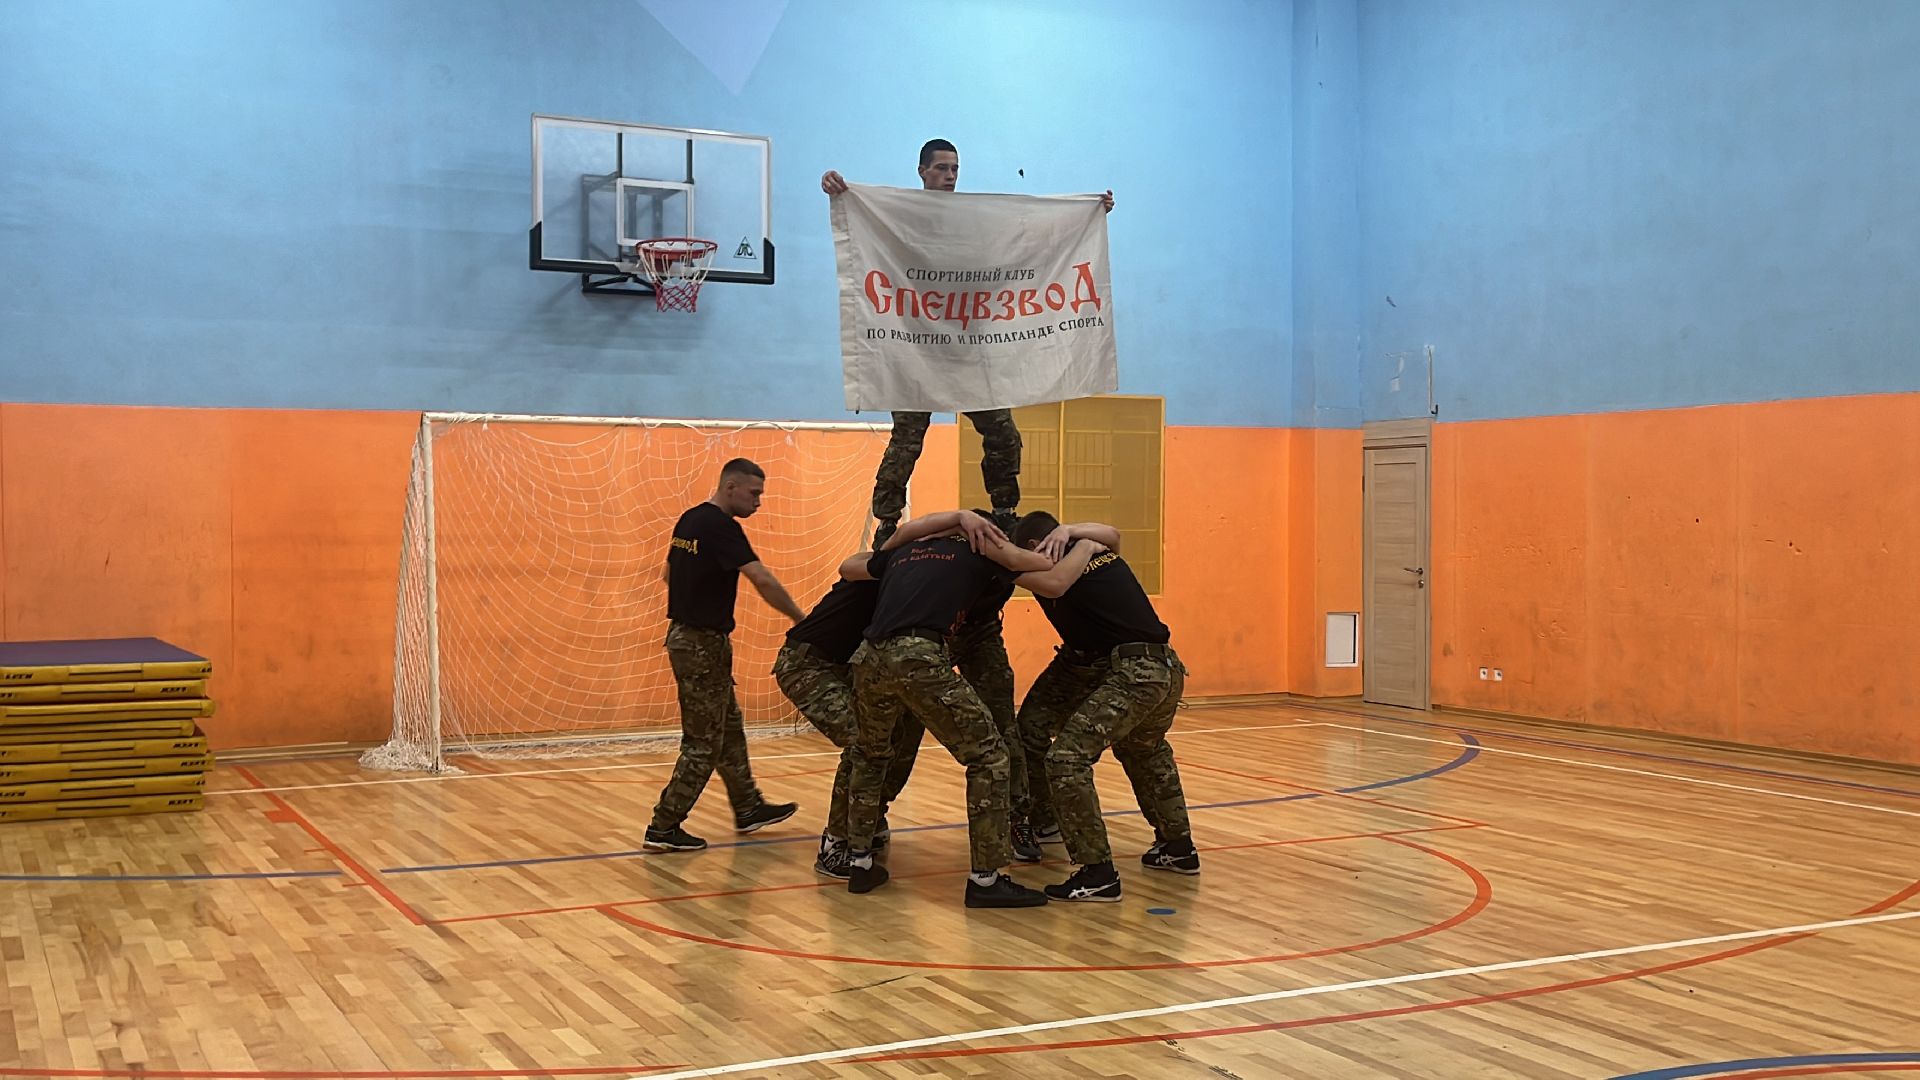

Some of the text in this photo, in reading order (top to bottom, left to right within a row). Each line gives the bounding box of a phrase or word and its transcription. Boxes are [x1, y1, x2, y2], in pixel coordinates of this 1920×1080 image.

[906, 267, 1035, 282] СПОРТИВНЫЙ КЛУБ
[867, 316, 1105, 345] ПО РАЗВИТИЮ И ПРОПАГАНДЕ СПОРТА
